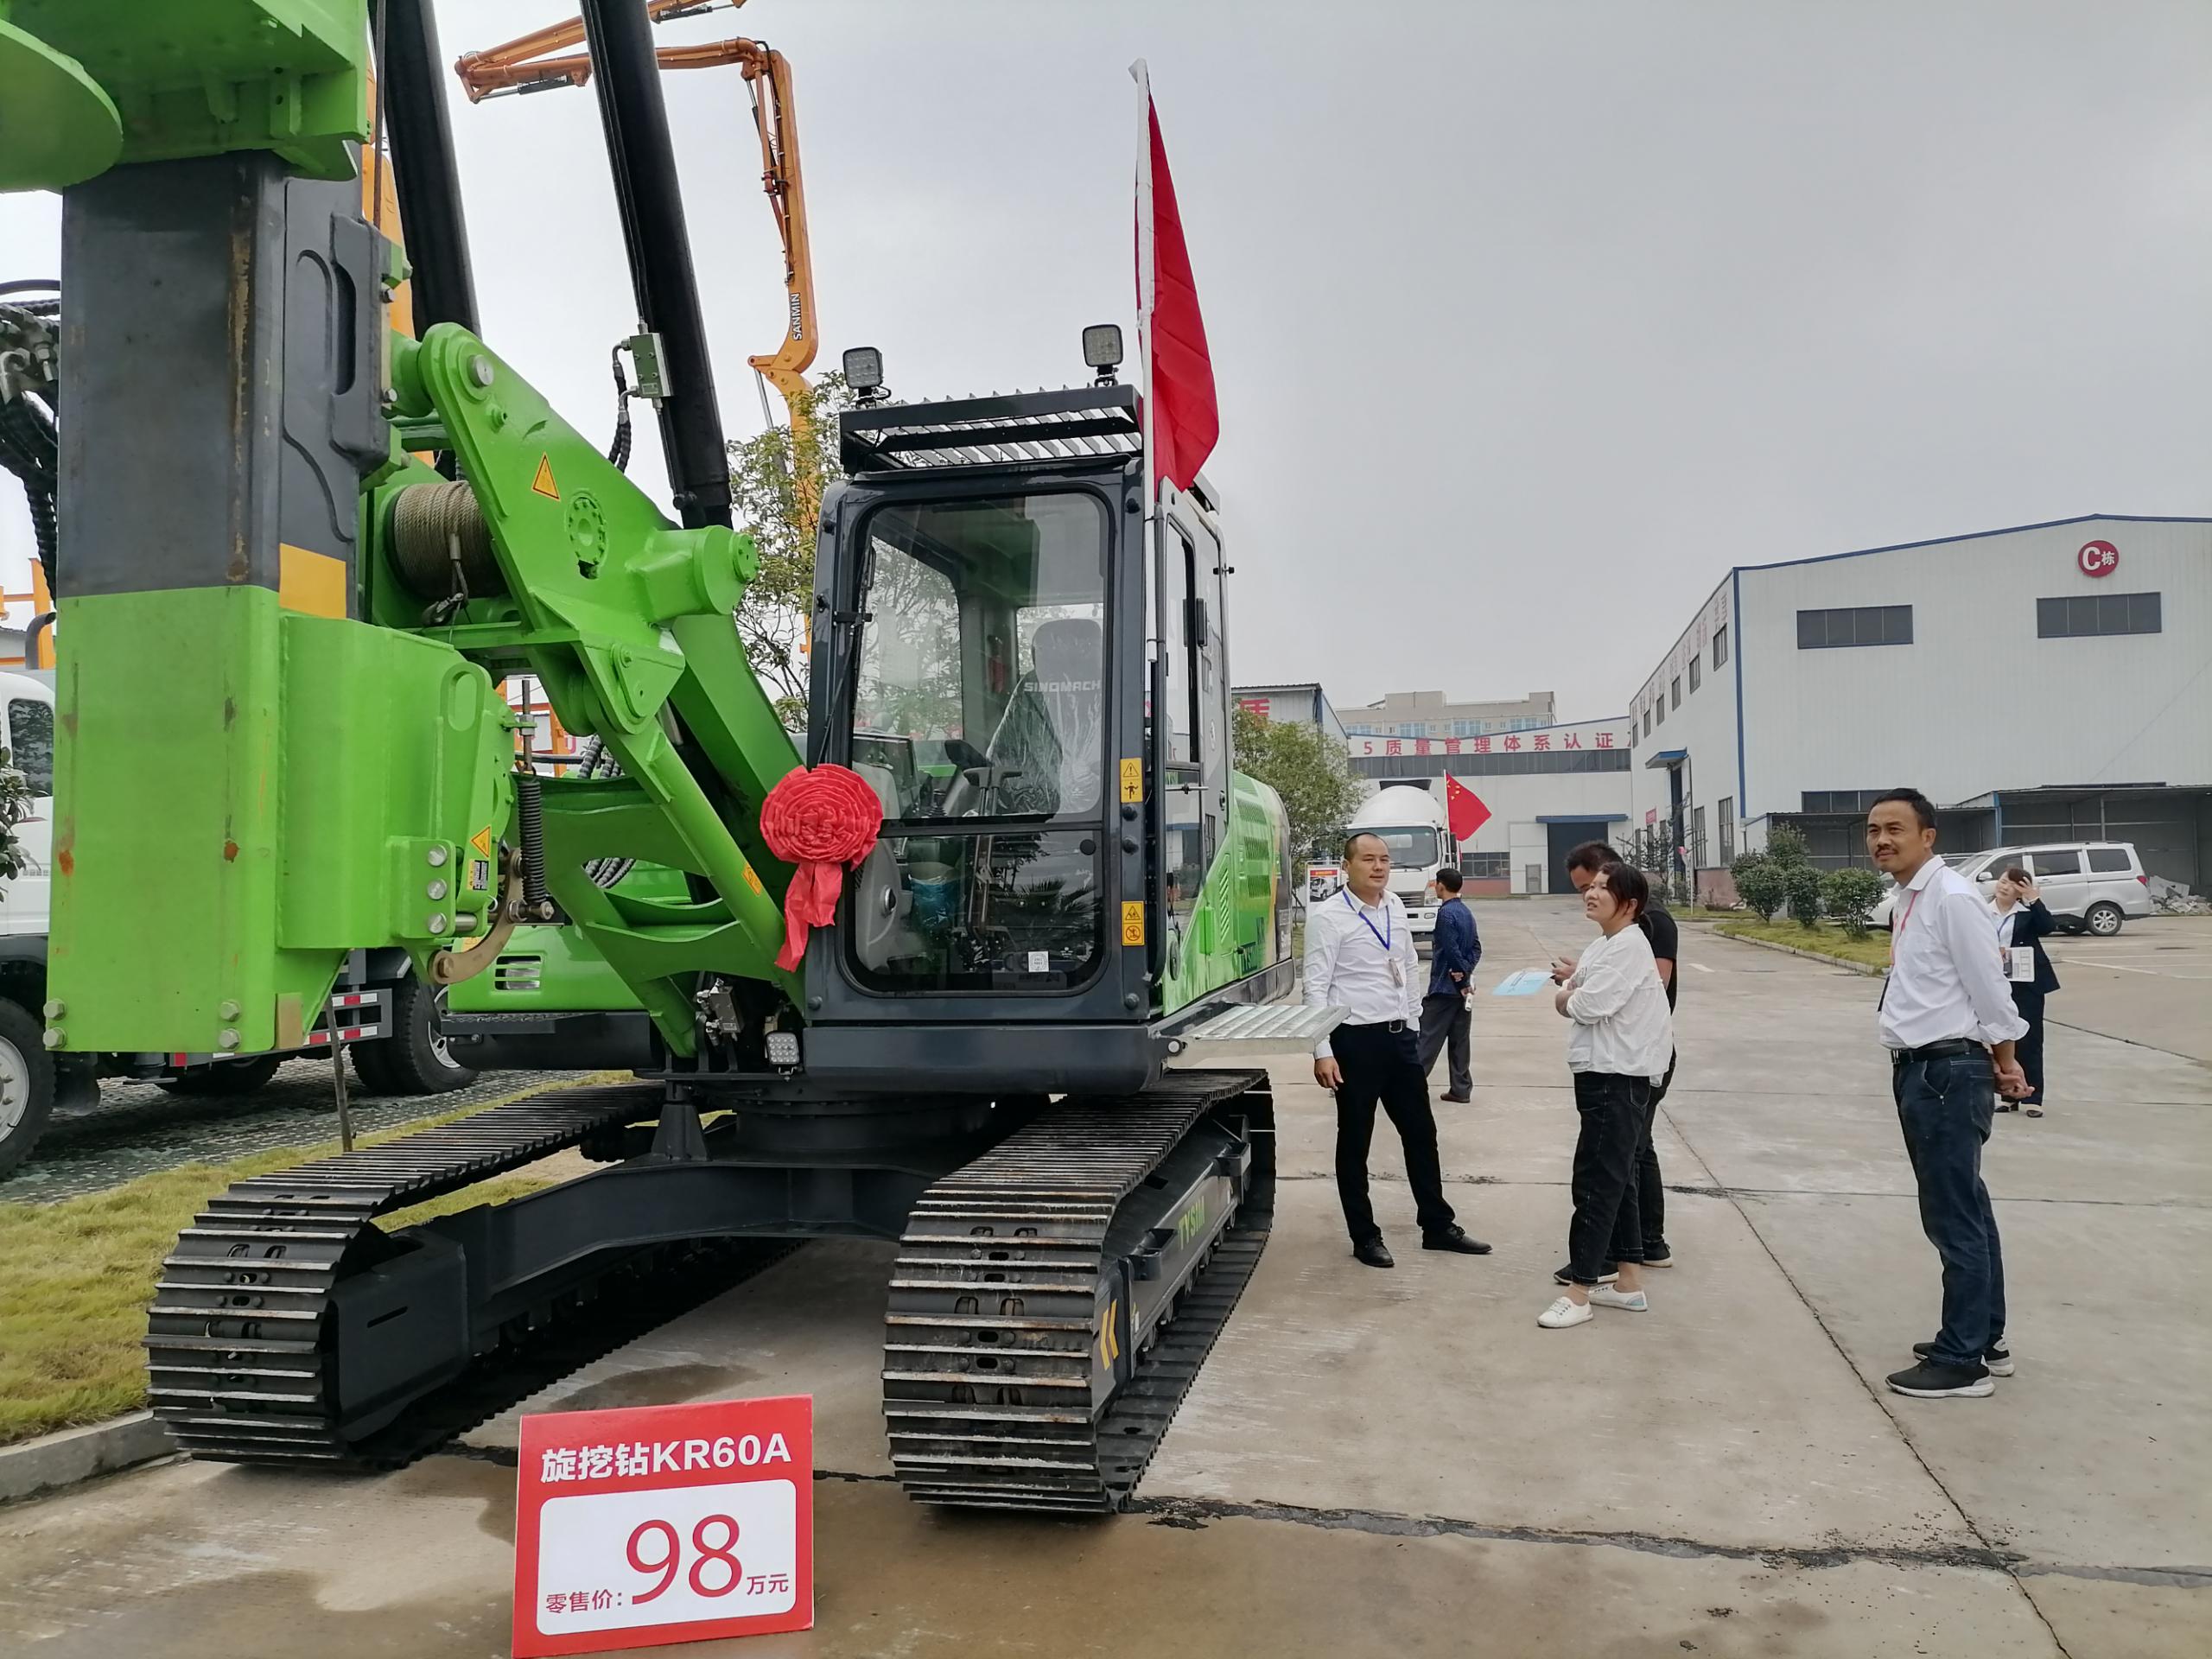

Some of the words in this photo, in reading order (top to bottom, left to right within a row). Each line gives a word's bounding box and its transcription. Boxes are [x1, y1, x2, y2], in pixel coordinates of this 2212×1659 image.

[791, 292, 802, 341] SANMIN
[2082, 546, 2115, 571] C栋
[1023, 678, 1102, 692] SINOMACH
[1363, 733, 1631, 756] 5质量管理体系认证
[540, 1433, 792, 1484] 旋挖钻KR60A
[626, 1514, 743, 1605] 98
[746, 1573, 790, 1596] 万元
